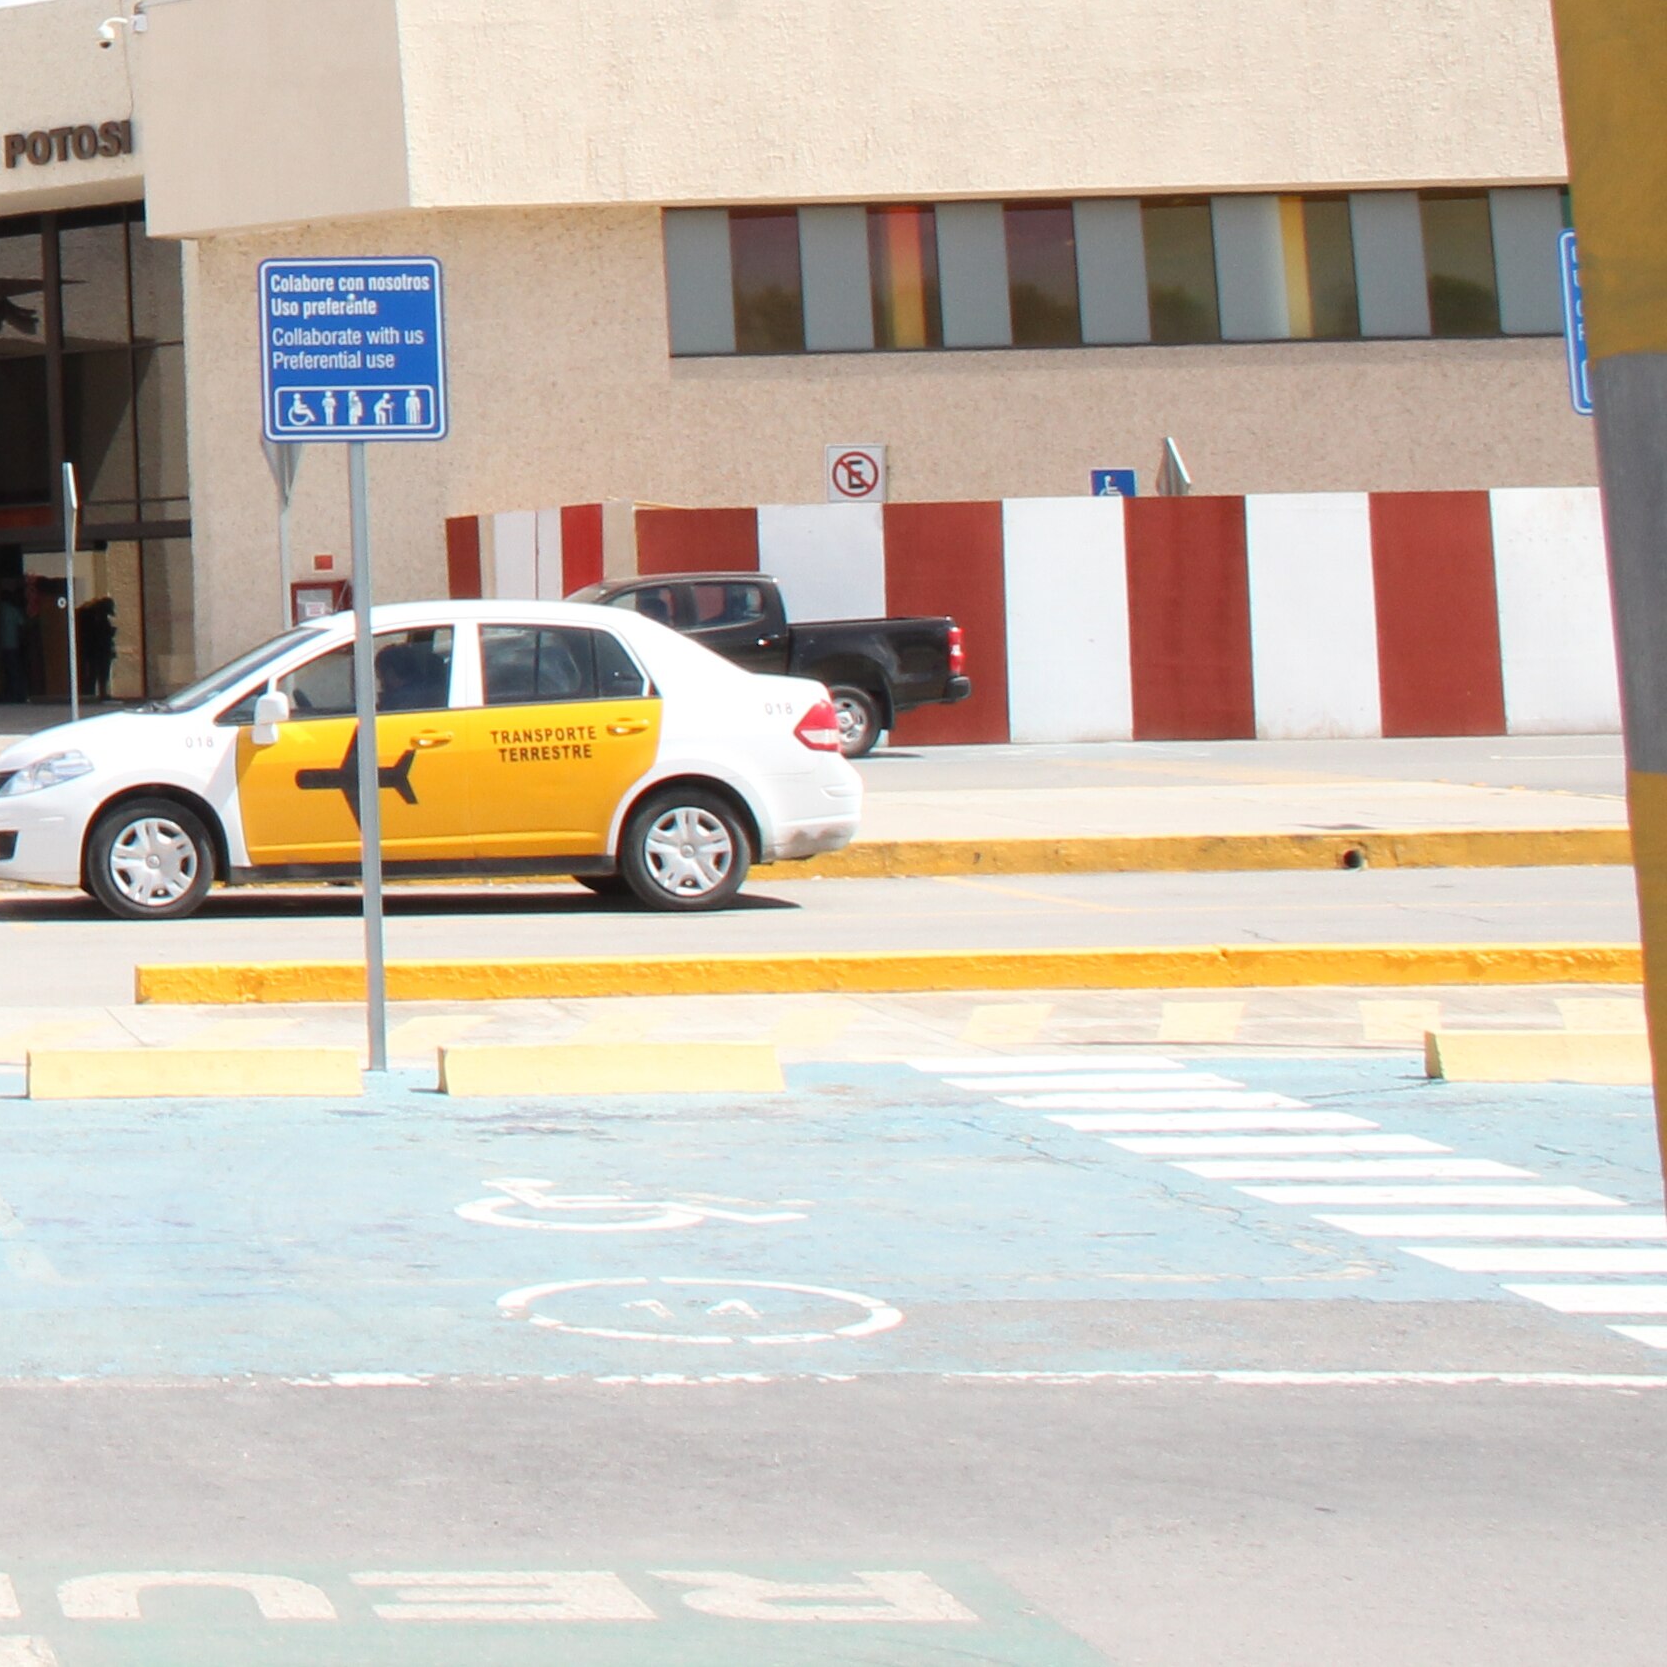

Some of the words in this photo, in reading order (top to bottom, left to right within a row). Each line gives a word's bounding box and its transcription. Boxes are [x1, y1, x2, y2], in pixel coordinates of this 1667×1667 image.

[3, 118, 134, 169] POTOSI
[270, 274, 334, 293] Colabore
[338, 277, 364, 291] con
[368, 273, 430, 291] nosotros
[271, 298, 299, 316] Uso
[303, 297, 377, 319] preferente
[272, 327, 362, 346] Collaborate
[366, 326, 400, 345] with
[404, 329, 424, 345] us
[272, 350, 361, 370] Preferential
[366, 353, 395, 368] use
[764, 702, 794, 716] 018
[185, 736, 214, 749] 018
[489, 725, 598, 745] TRANSPORTE
[499, 744, 593, 763] TERRESTRE
